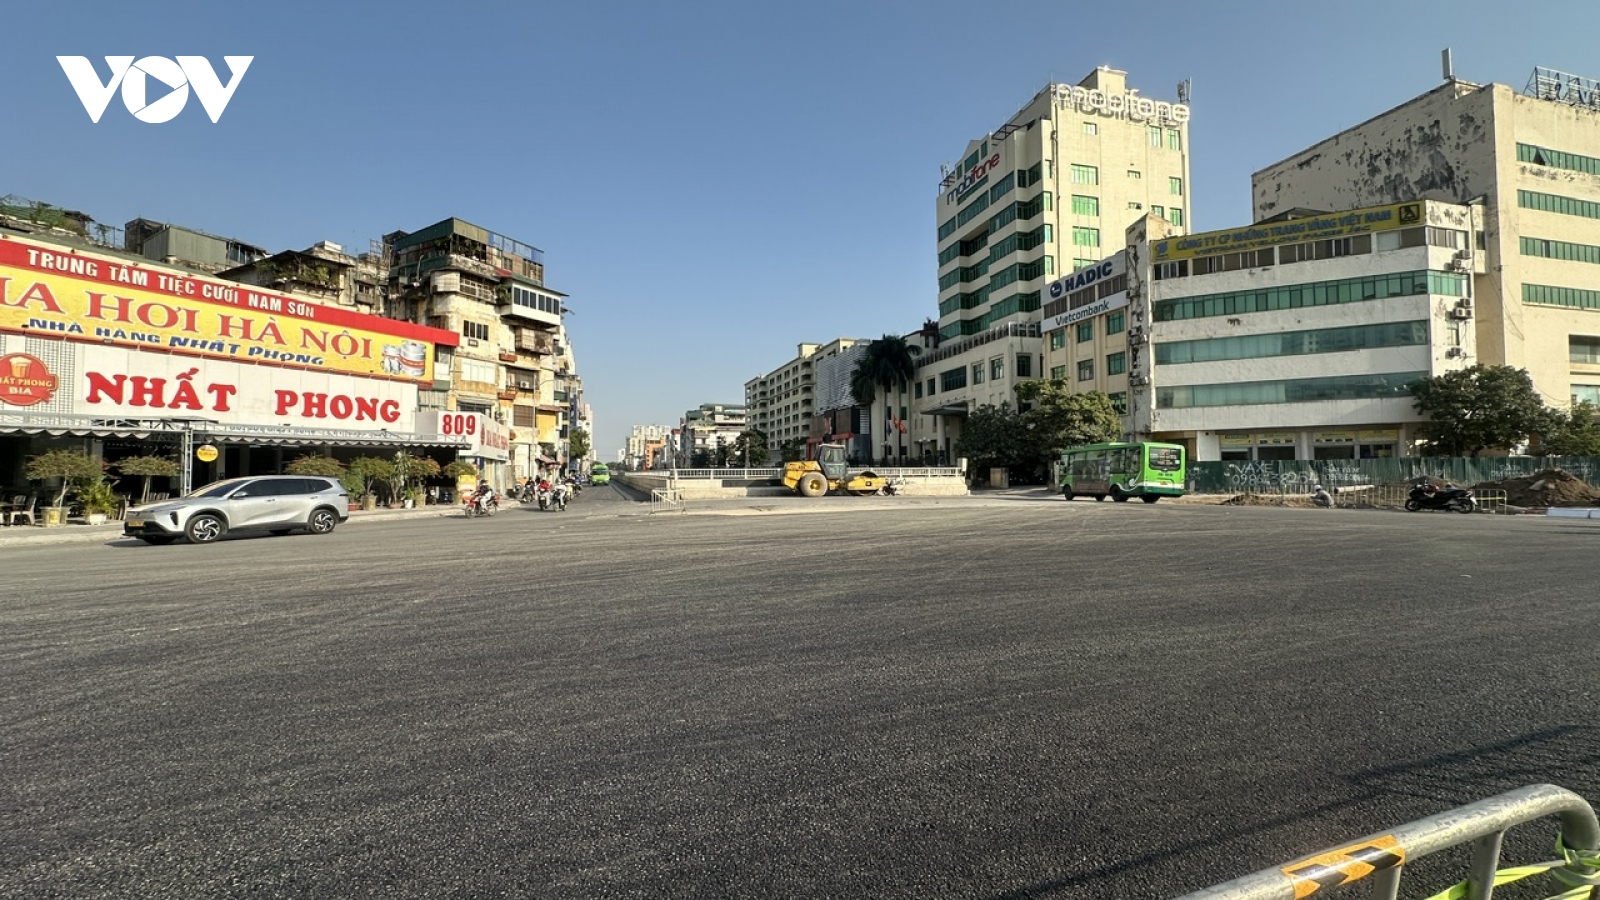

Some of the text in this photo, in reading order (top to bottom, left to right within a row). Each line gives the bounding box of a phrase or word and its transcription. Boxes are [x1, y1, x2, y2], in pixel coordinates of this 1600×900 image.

[1055, 83, 1191, 122] mobifone
[946, 151, 1001, 206] mobifone
[1176, 238, 1203, 251] CÔNG
[1204, 236, 1217, 246] TY
[1218, 233, 1231, 245] CP
[1270, 223, 1306, 236] TRANG
[1364, 210, 1392, 223] NAM
[27, 249, 315, 318] TRUNG TÂM TIỆC CƯỚI NAM SƠN
[1065, 261, 1113, 292] HADIC
[84, 290, 200, 333] HƠI
[217, 313, 288, 346] HÀ
[300, 327, 373, 360] NỘI
[1055, 299, 1110, 326] Vietcombank
[29, 318, 324, 366] NHÀ HÀNG NHẤT PHONG
[9, 386, 33, 395] BIA
[18, 378, 53, 387] PHONG
[85, 367, 401, 423] NHẤT PHONG
[442, 414, 476, 436] 809
